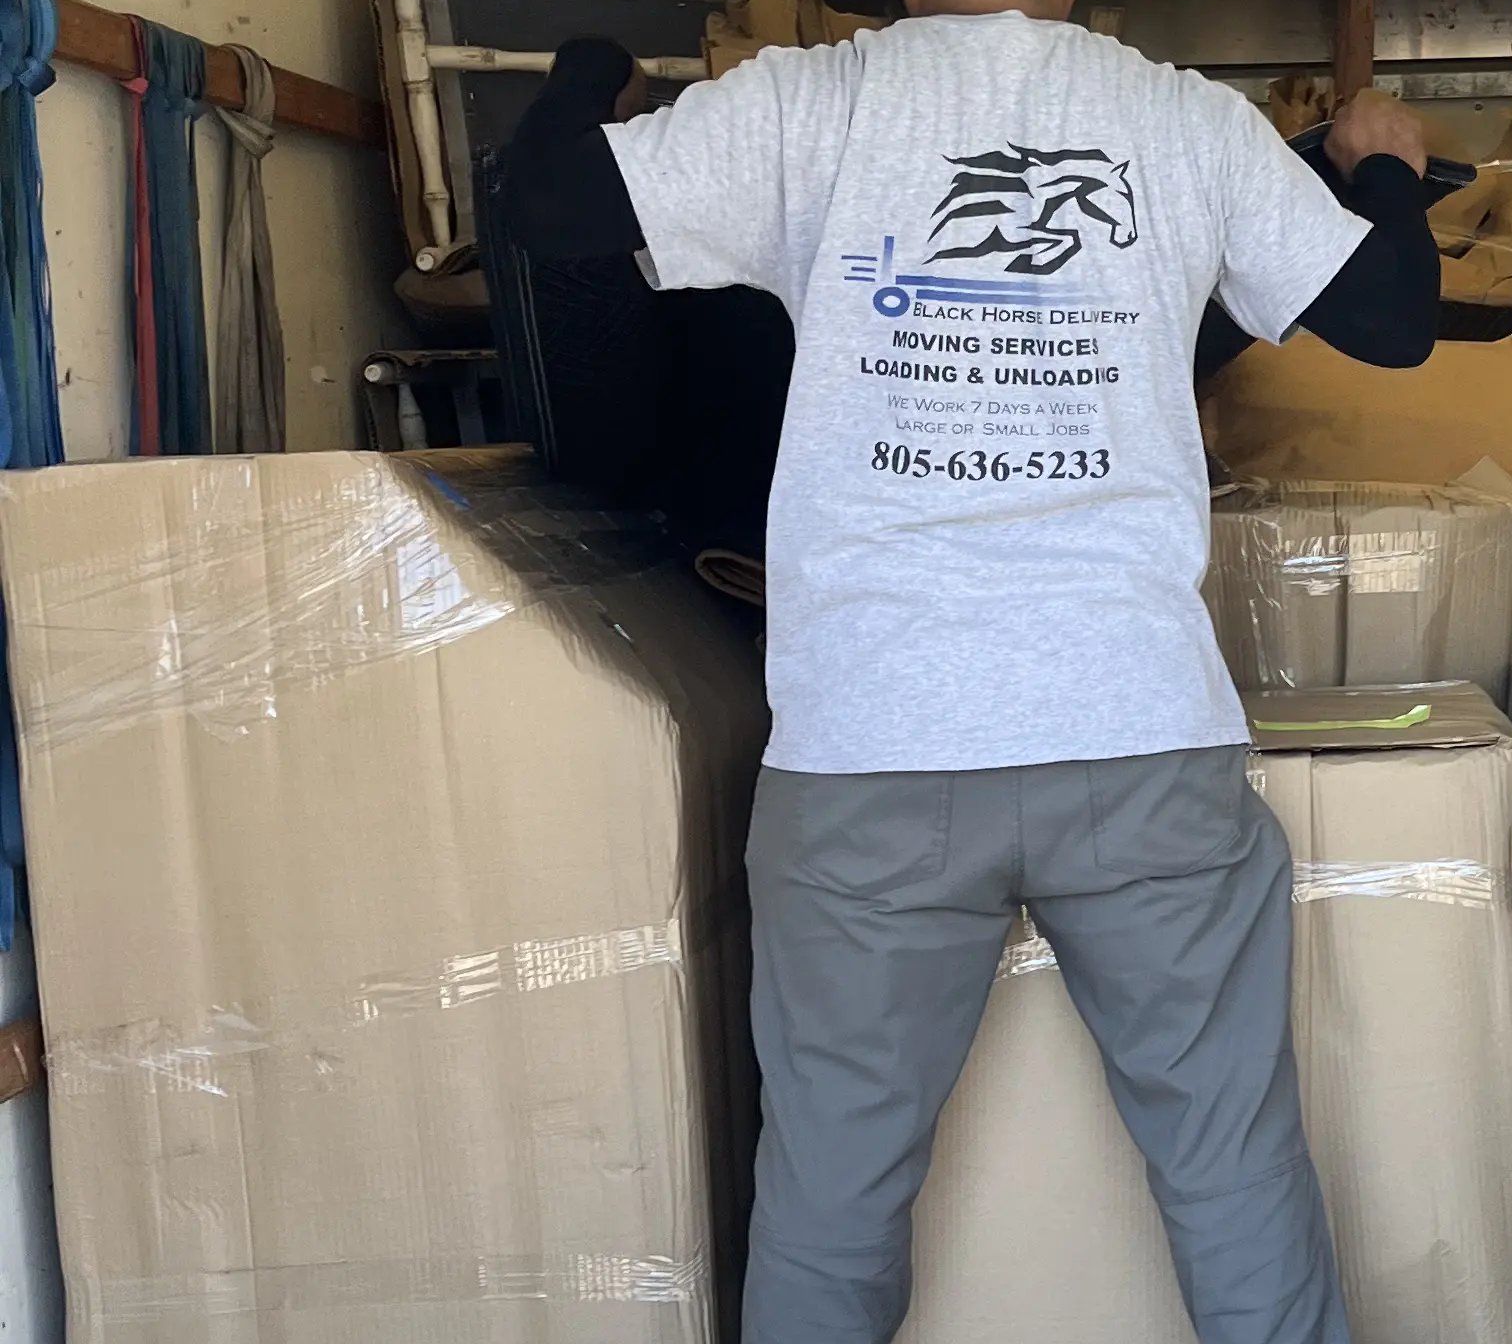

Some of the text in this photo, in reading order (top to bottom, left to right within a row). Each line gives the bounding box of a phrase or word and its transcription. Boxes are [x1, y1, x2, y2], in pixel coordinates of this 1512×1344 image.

[912, 301, 975, 322] BLACK
[892, 329, 1099, 357] MOVING SERVICES
[860, 356, 1120, 386] LOADING & UNLOADING
[913, 397, 965, 413] WORK
[970, 400, 982, 414] 7
[987, 401, 1031, 415] DAYS
[1048, 402, 1099, 416] WEEK
[982, 422, 1040, 436] SMALL
[1045, 421, 1091, 436] JOBS
[871, 441, 1111, 482] 805-636-5233
